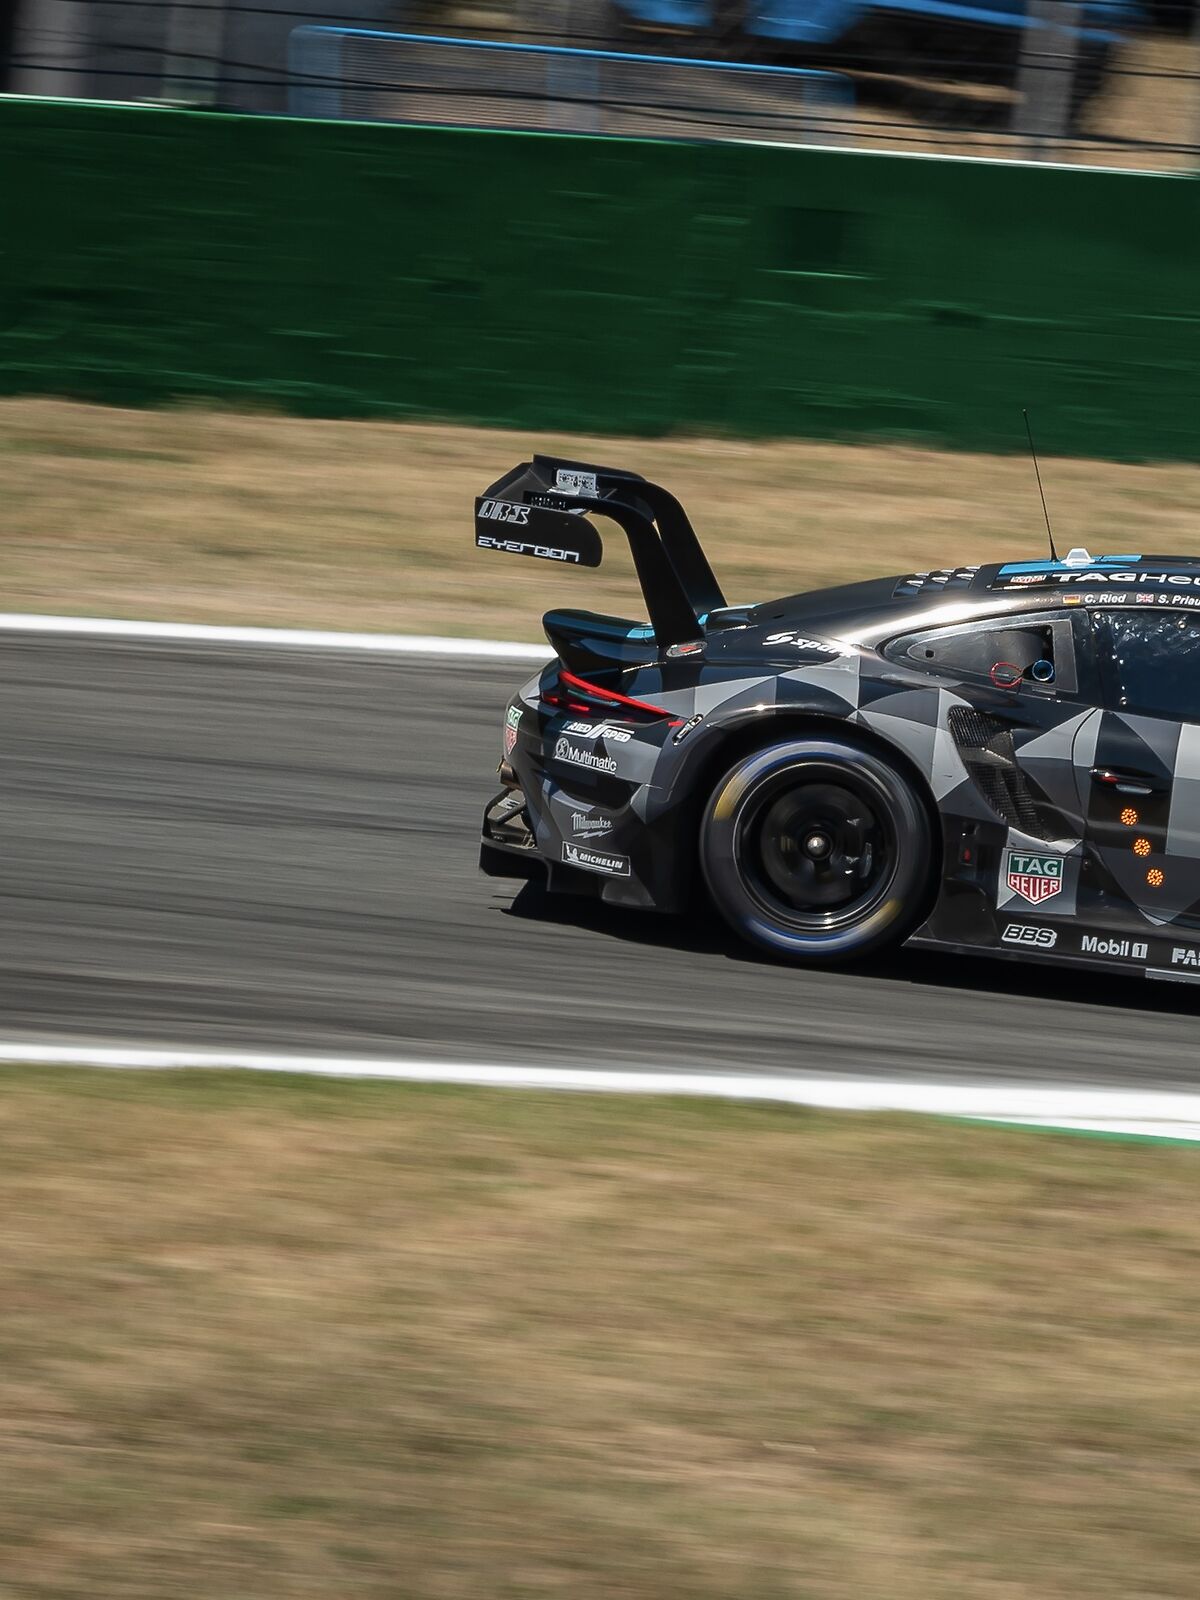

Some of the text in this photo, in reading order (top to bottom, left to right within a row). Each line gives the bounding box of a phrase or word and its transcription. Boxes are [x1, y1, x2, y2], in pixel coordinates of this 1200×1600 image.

[1084, 594, 1097, 604] C.
[1158, 595, 1170, 605] S.
[568, 746, 617, 771] Multimatic
[571, 811, 613, 831] Milwaukee
[579, 852, 624, 869] MICHELIN
[1014, 856, 1058, 877] TAG
[1010, 876, 1059, 902] HEUER
[1002, 924, 1057, 948] BBS
[1081, 935, 1129, 957] Mobil
